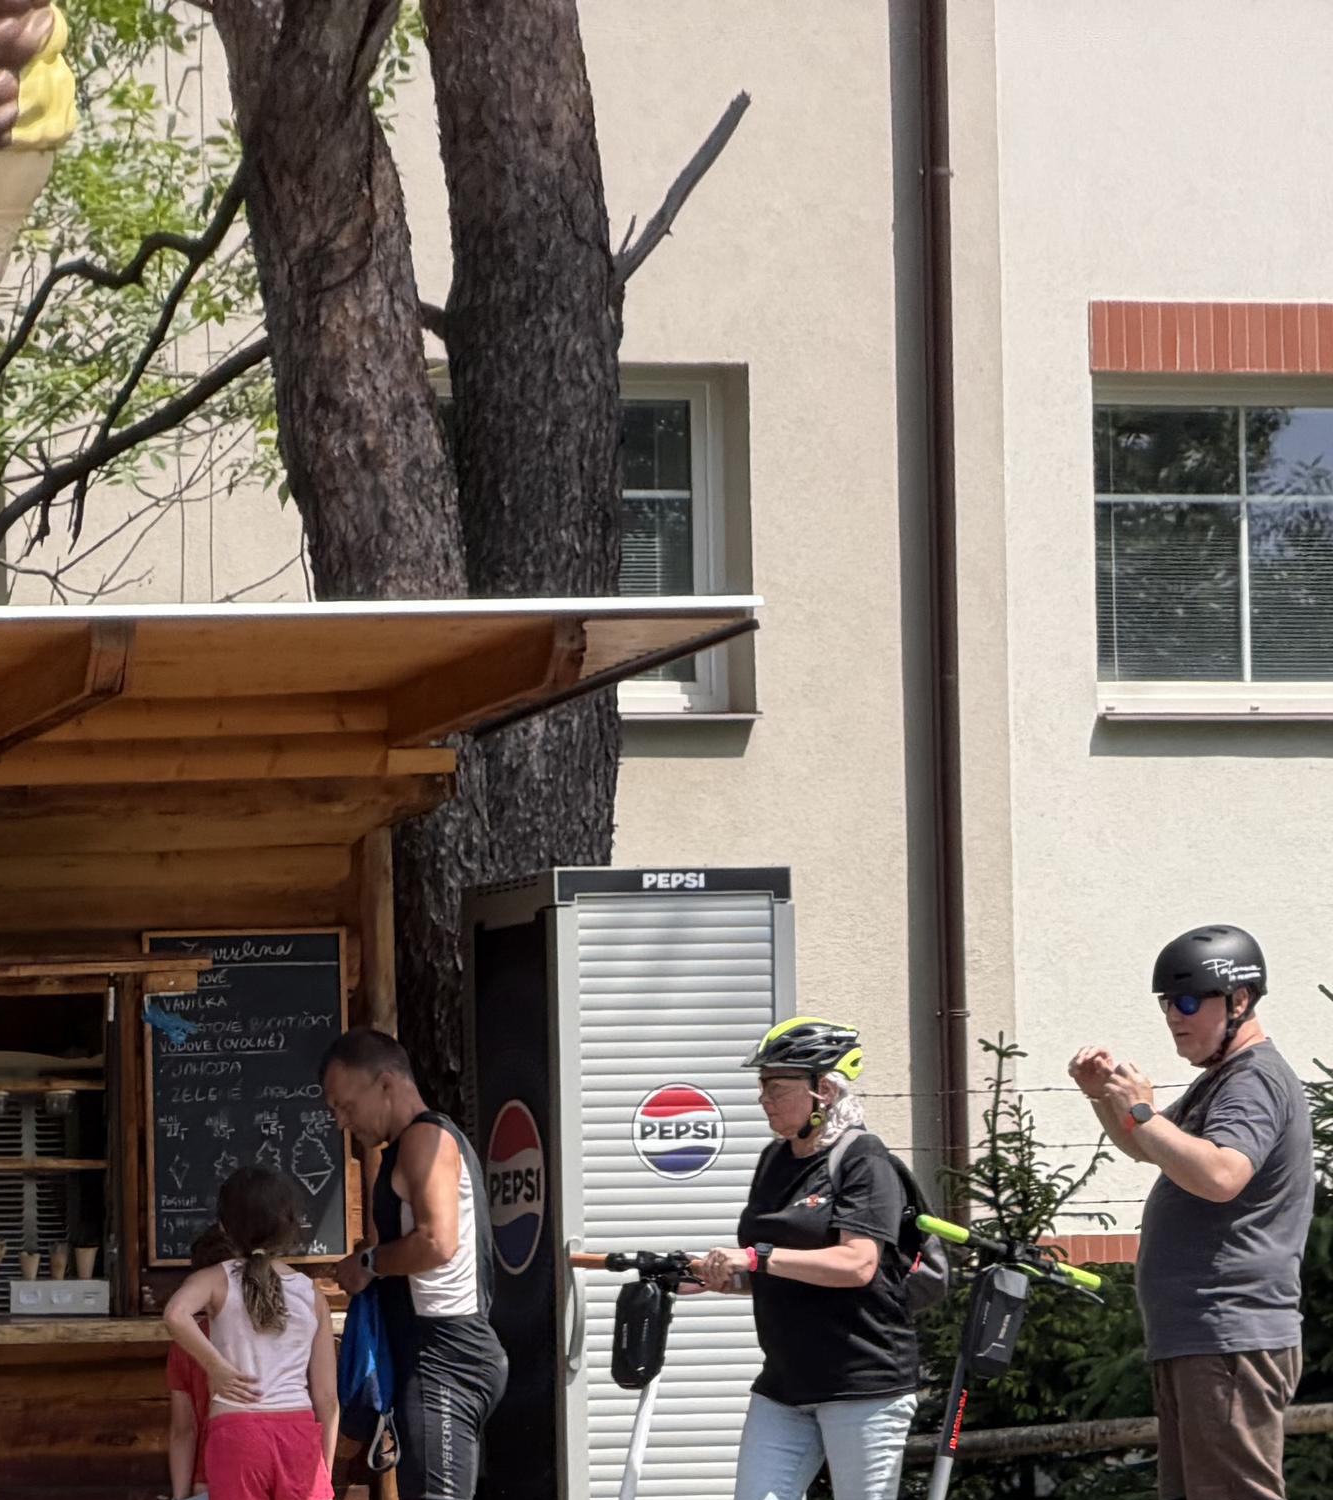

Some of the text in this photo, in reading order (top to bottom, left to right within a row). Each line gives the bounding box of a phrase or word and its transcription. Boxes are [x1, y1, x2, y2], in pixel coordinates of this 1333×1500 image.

[642, 872, 705, 889] PEPSI
[171, 1061, 243, 1077] JAHODA
[640, 1121, 717, 1141] PEPSI
[490, 1166, 542, 1208] PEPSI
